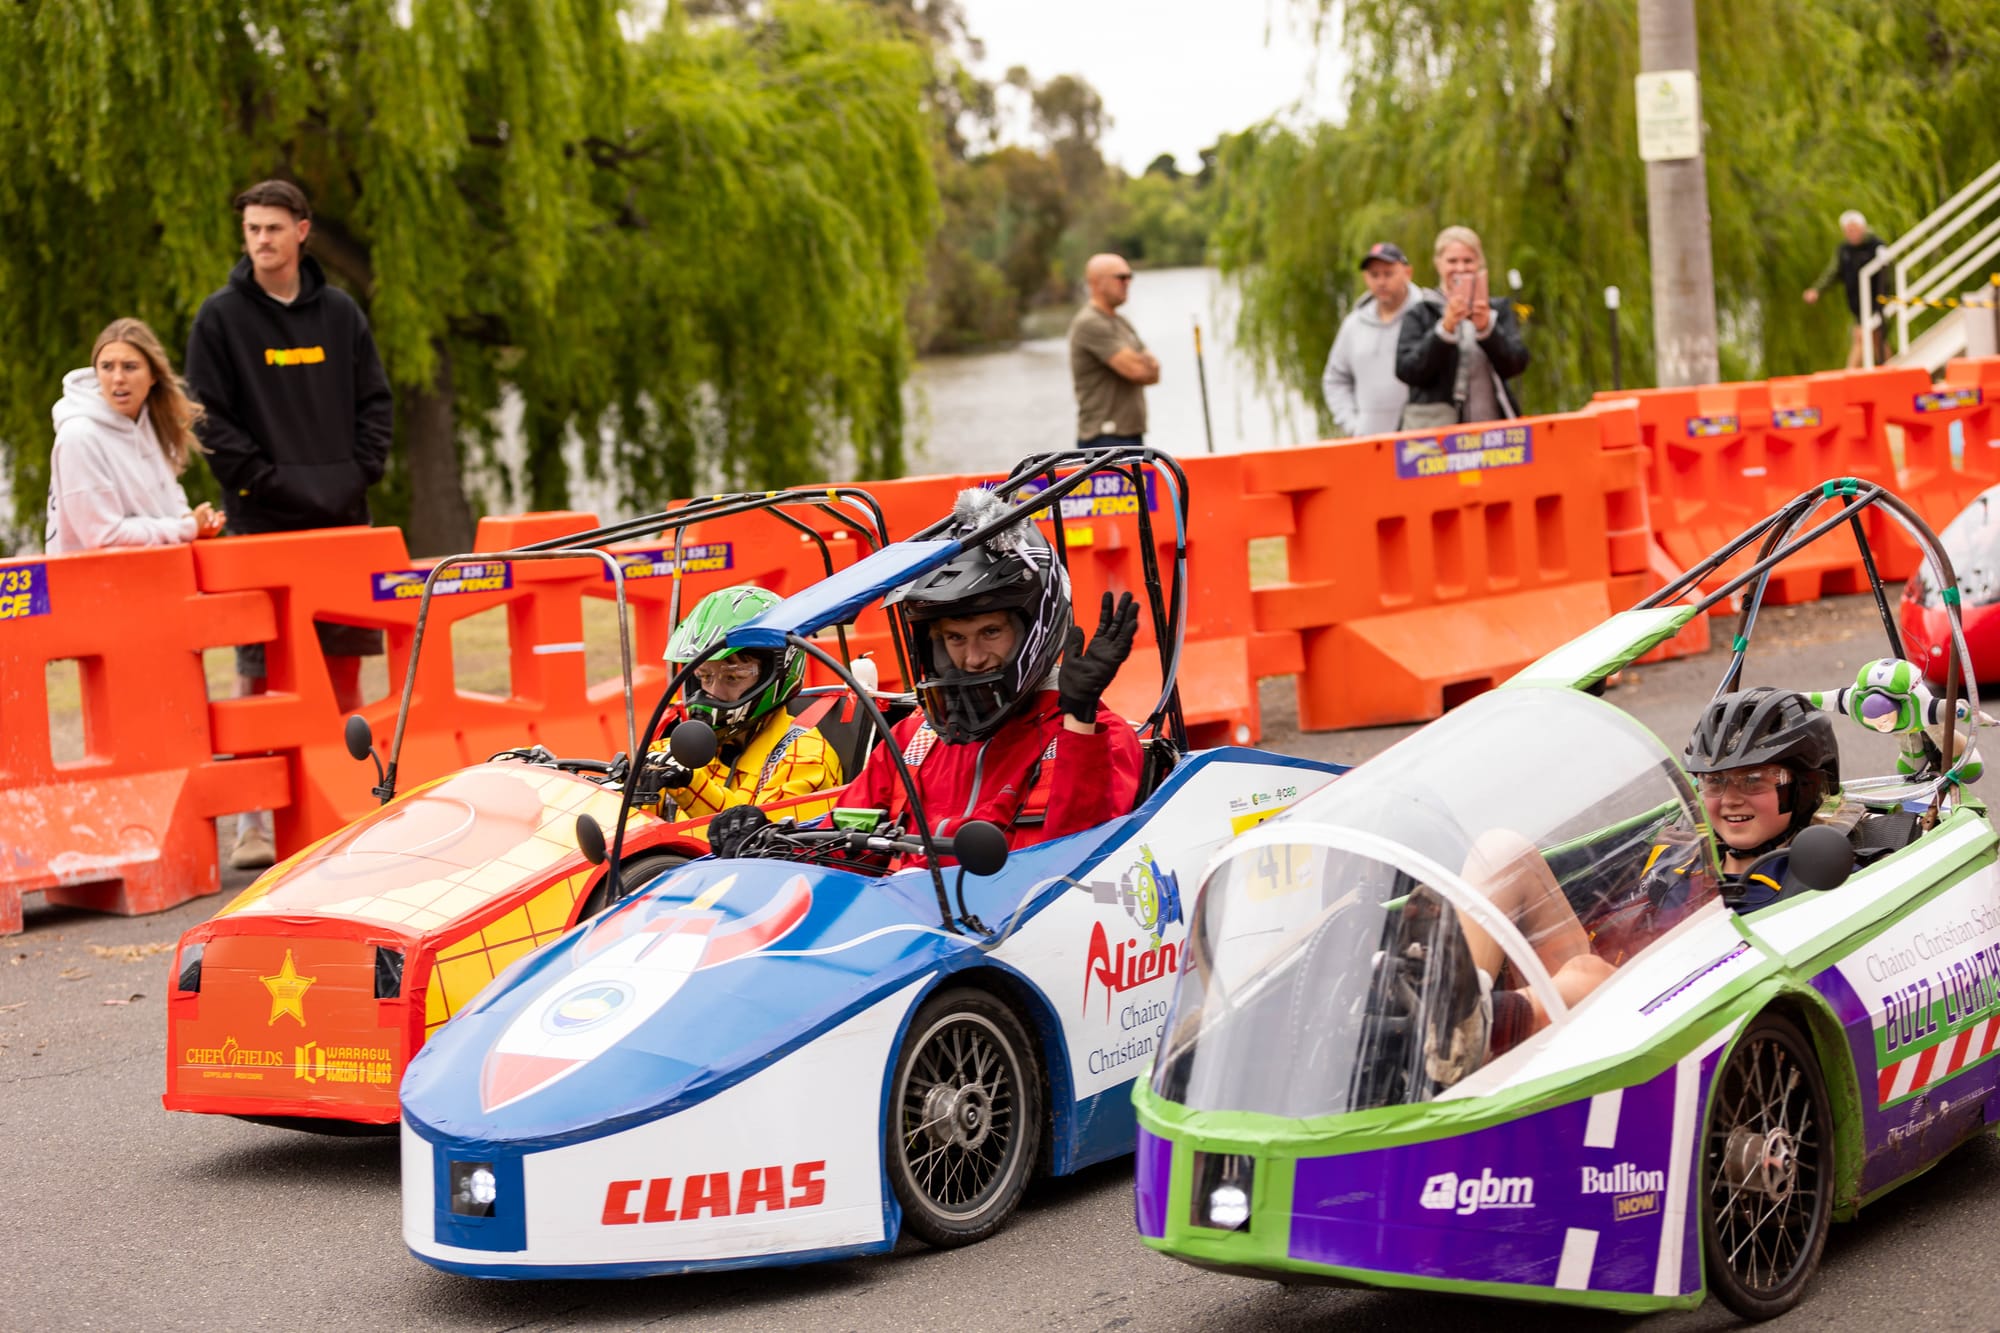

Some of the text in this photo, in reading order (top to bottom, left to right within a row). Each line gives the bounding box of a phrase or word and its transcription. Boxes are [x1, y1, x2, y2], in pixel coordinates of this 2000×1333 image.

[1094, 476, 1119, 495] 836
[1866, 947, 1916, 983] Chairo
[1913, 921, 1979, 961] Christian
[1120, 999, 1167, 1031] Chairo
[1882, 978, 1938, 1054] BUZZ
[186, 1048, 284, 1066] CHEF FIELDS
[326, 1047, 392, 1061] WARRAGUL
[1088, 1037, 1153, 1075] Christian
[601, 1160, 826, 1226] CLAAS
[1456, 1168, 1535, 1215] gbm
[1581, 1162, 1664, 1194] Bullion
[1617, 1194, 1655, 1216] NOW
